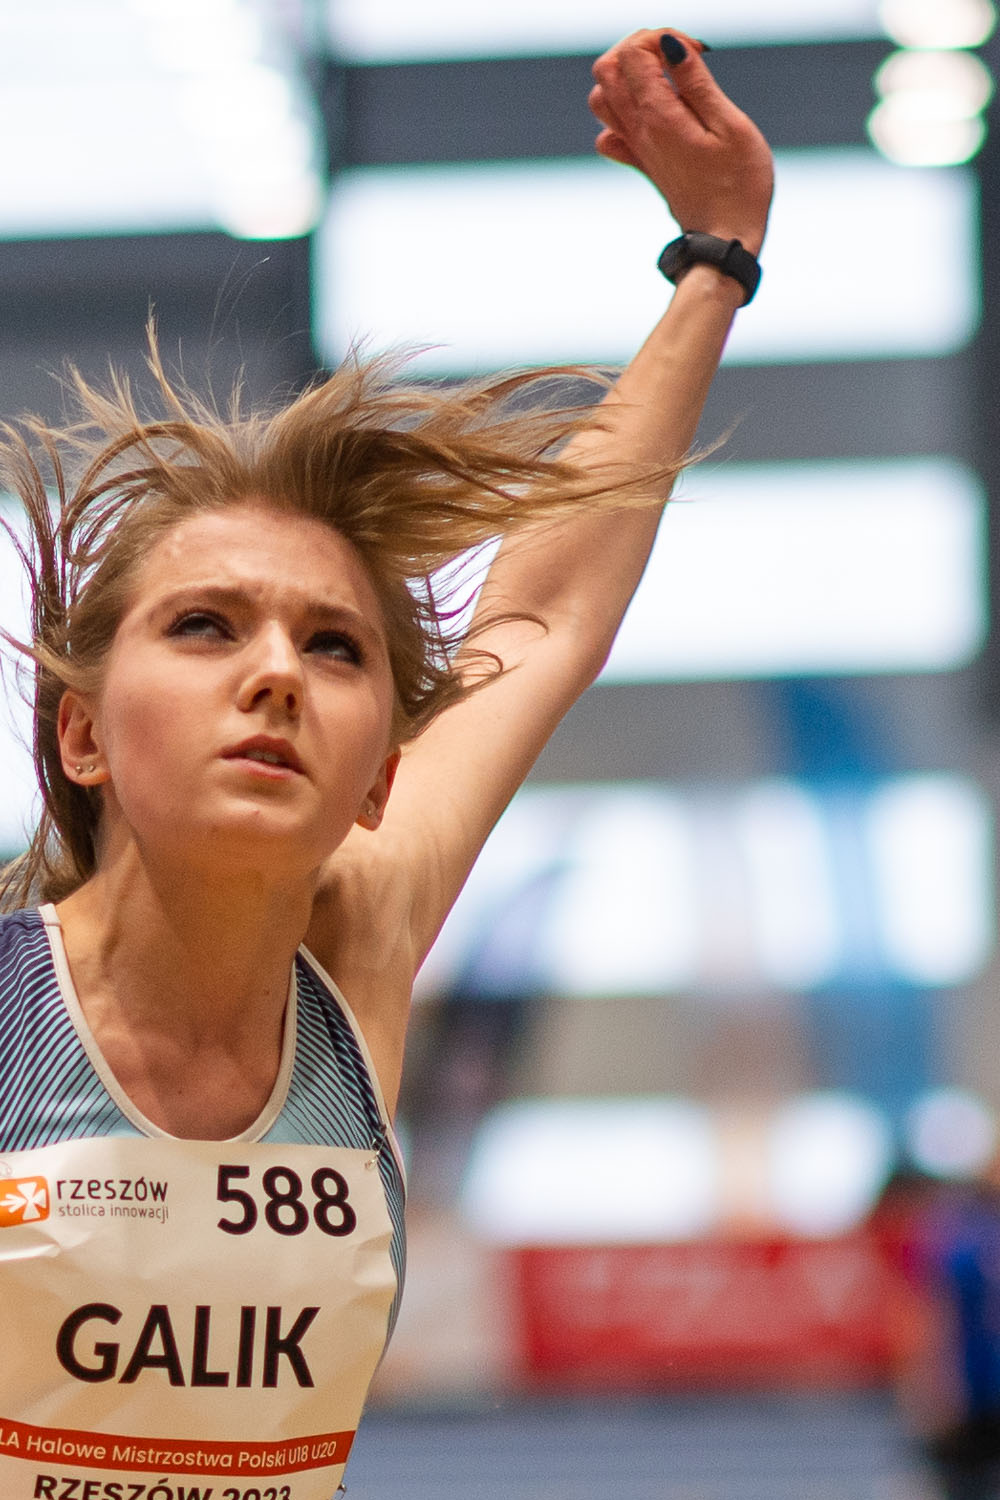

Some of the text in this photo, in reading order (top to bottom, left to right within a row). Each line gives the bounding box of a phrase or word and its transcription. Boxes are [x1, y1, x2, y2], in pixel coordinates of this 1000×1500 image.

[56, 1176, 168, 1202] rzeszów
[216, 1164, 357, 1237] 588
[59, 1203, 169, 1224] stolica innowacji
[55, 1302, 321, 1389] GALIK
[26, 1435, 107, 1460] Halowe
[112, 1445, 233, 1468] Mistrzostwa
[238, 1450, 286, 1468] Polski
[288, 1445, 309, 1465] U18
[312, 1441, 337, 1460] U20
